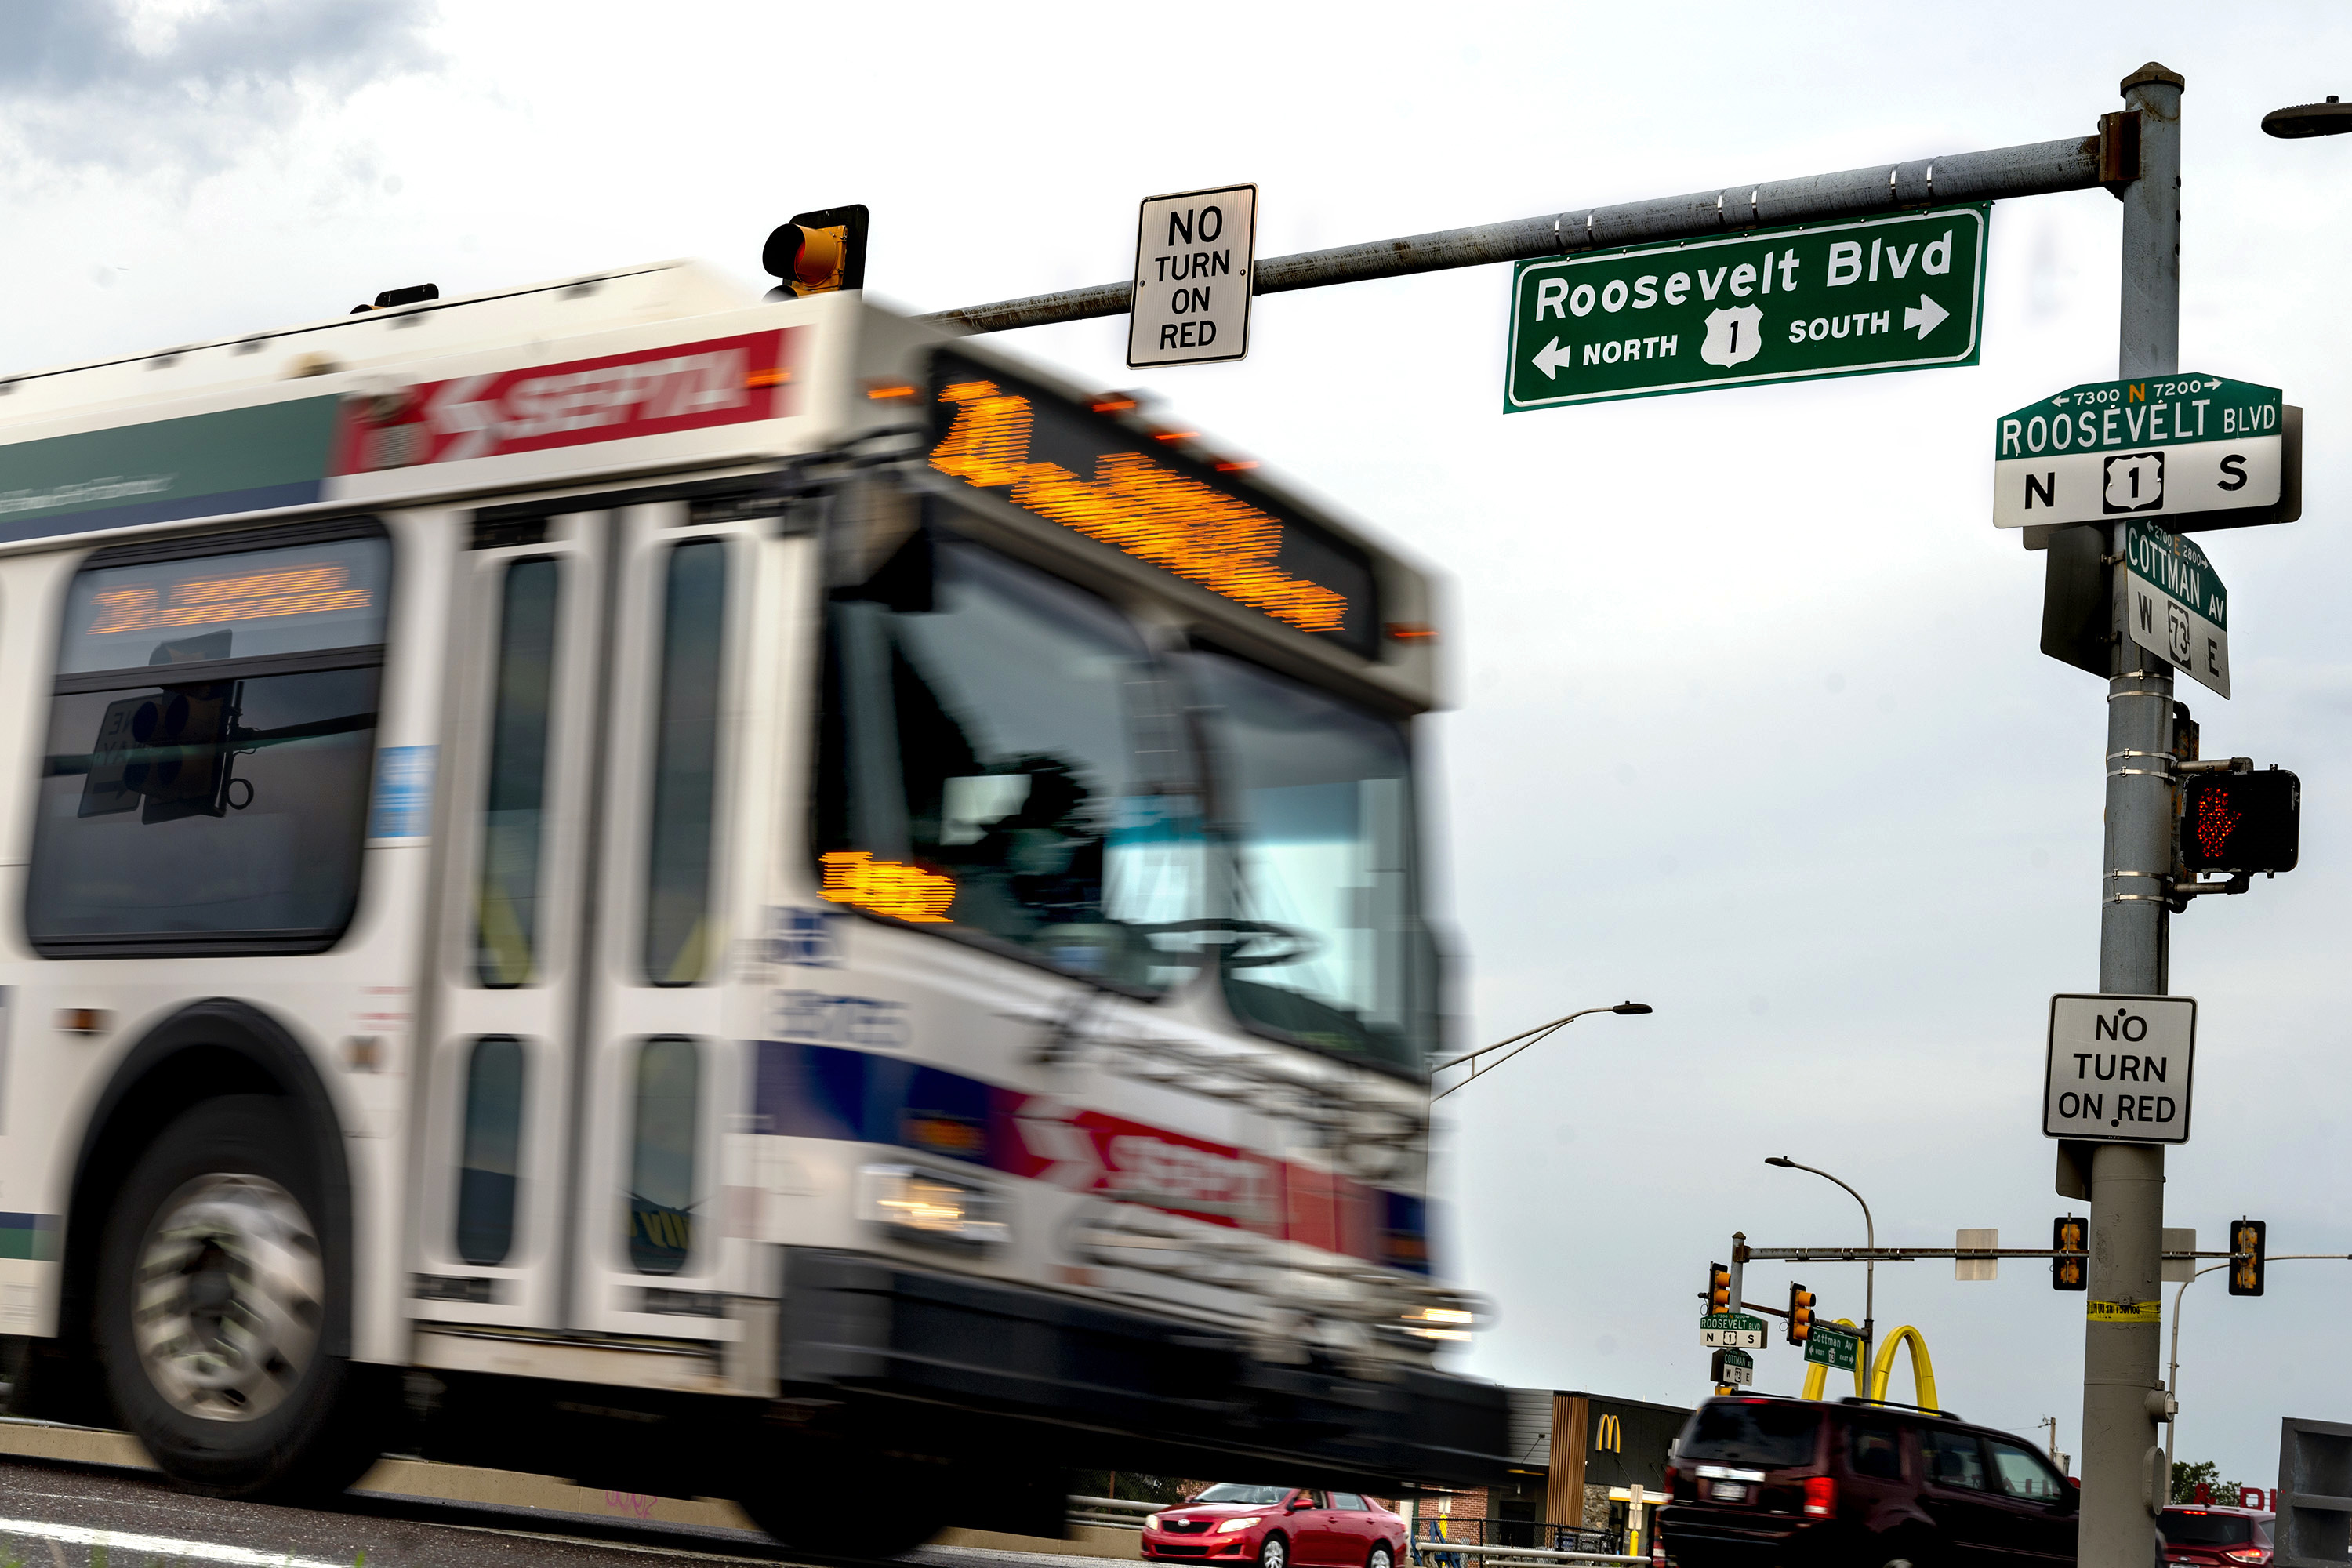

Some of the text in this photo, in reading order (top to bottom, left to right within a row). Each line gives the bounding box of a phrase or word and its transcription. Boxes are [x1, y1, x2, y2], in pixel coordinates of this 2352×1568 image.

[1168, 205, 1222, 246] NO
[1155, 249, 1230, 282] TURN
[1535, 230, 1953, 321] Roosevelt Blvd
[1171, 286, 1210, 314] ON
[1160, 320, 1217, 350] RED
[1583, 310, 1889, 366] NORTH 1 SOUTH
[2074, 380, 2201, 405] 7300 N 7200
[2002, 399, 2276, 456] ROOSEVELT BLVD
[2024, 454, 2248, 510] N 1 S
[2154, 525, 2201, 566] 2700 E 2800
[2129, 527, 2224, 622] COTTMAN AV
[2137, 591, 2220, 677] W 73 E
[2096, 1014, 2147, 1042] NO
[2073, 1053, 2167, 1082] TURN
[2058, 1091, 2176, 1123] ON RED
[1701, 1319, 1747, 1329] ROOSEVELT
[1707, 1333, 1755, 1344] N 1 S
[1813, 1330, 1853, 1351] Cottman Av
[1725, 1354, 1746, 1366] COTTMAN
